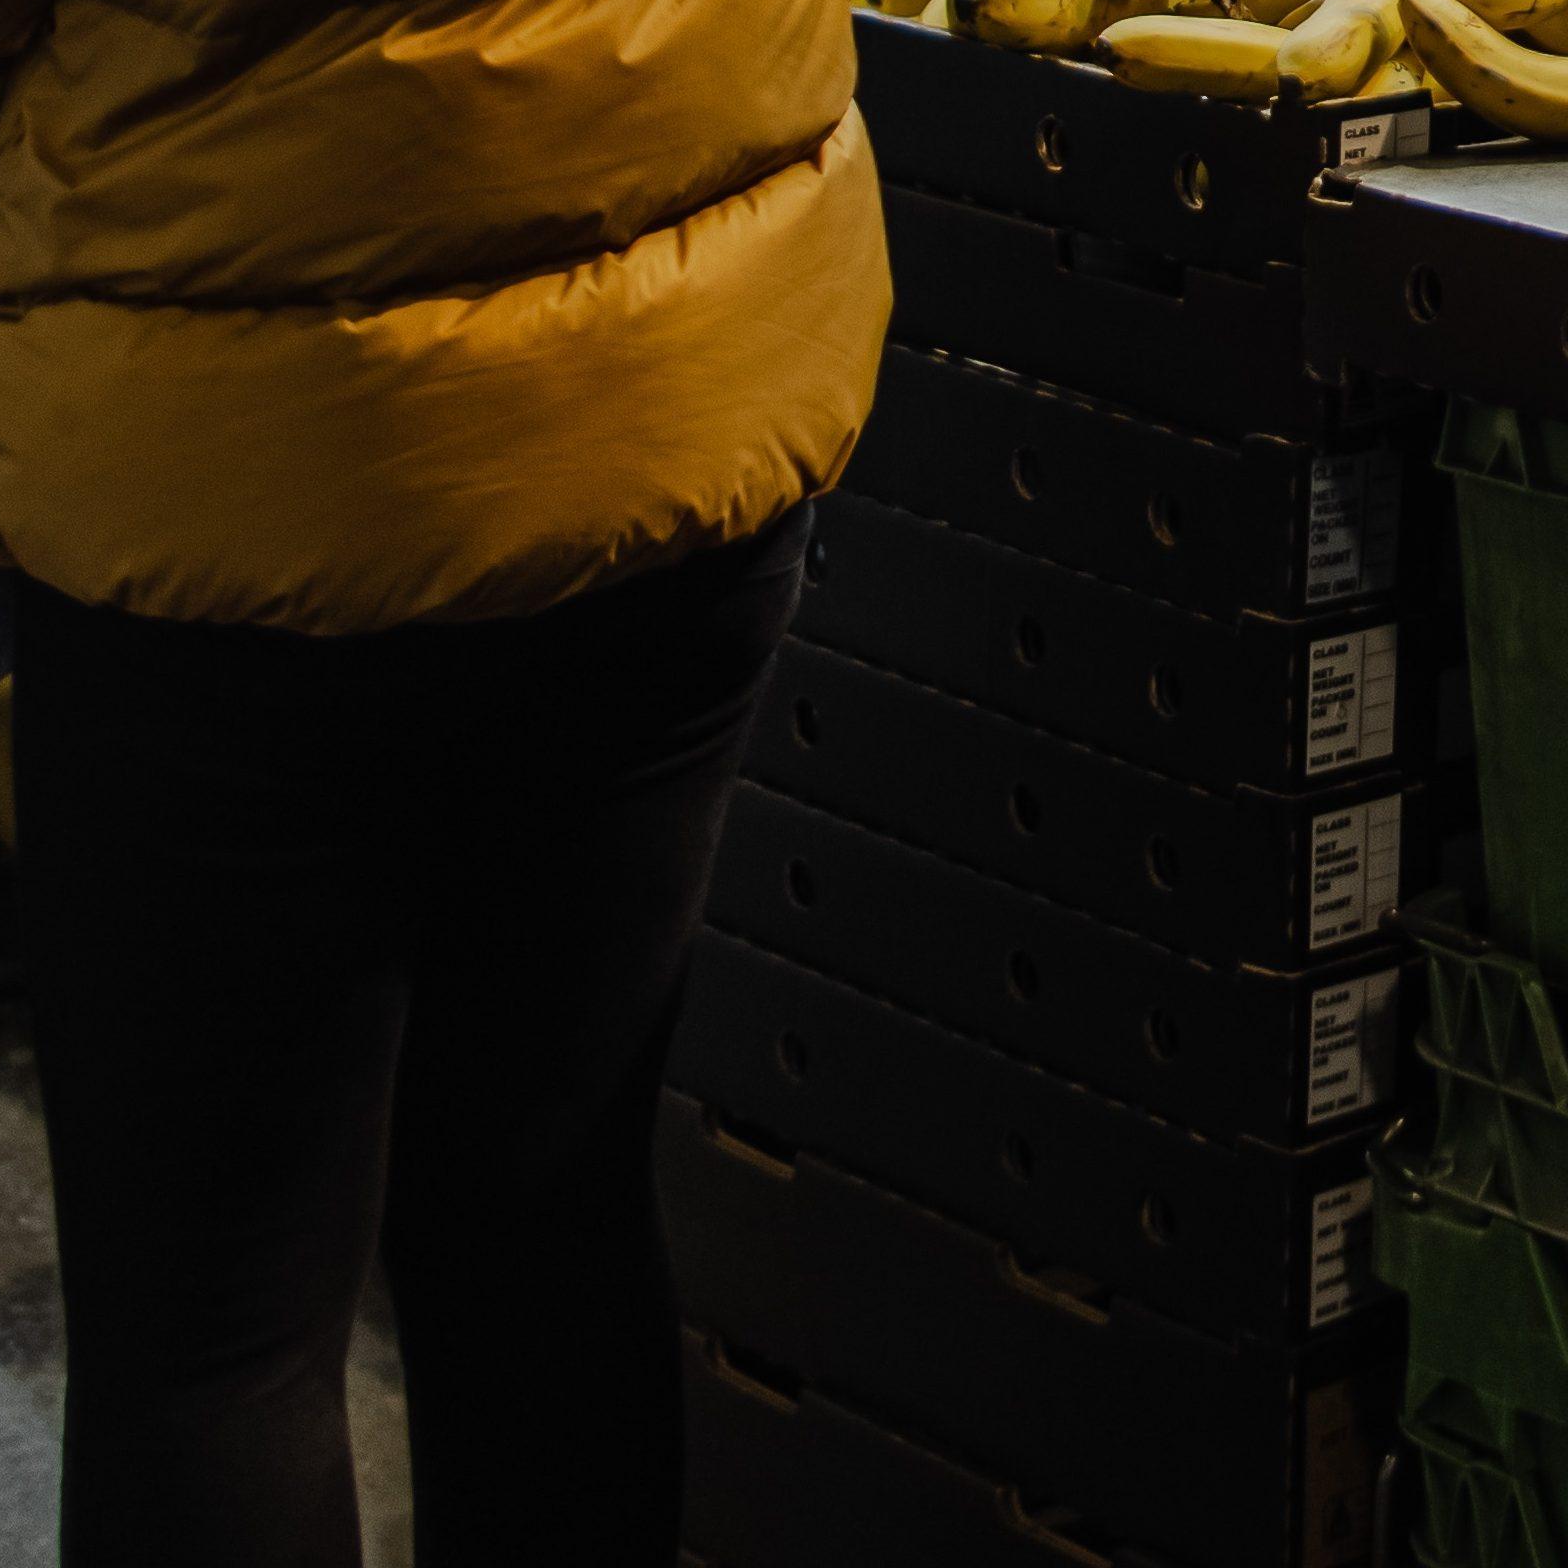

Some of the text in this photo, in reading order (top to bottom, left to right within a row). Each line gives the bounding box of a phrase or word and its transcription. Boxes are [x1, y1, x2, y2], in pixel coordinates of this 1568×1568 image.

[1344, 124, 1381, 140] CLASS
[1344, 146, 1367, 160] NET
[1309, 548, 1353, 568] COUNT
[1312, 642, 1349, 660] CLASS
[1312, 666, 1335, 680] NET
[1312, 673, 1355, 692] WEIGHT
[1311, 688, 1356, 706] PACKED
[1310, 722, 1349, 741] COUNT
[1316, 815, 1352, 834] CLASS
